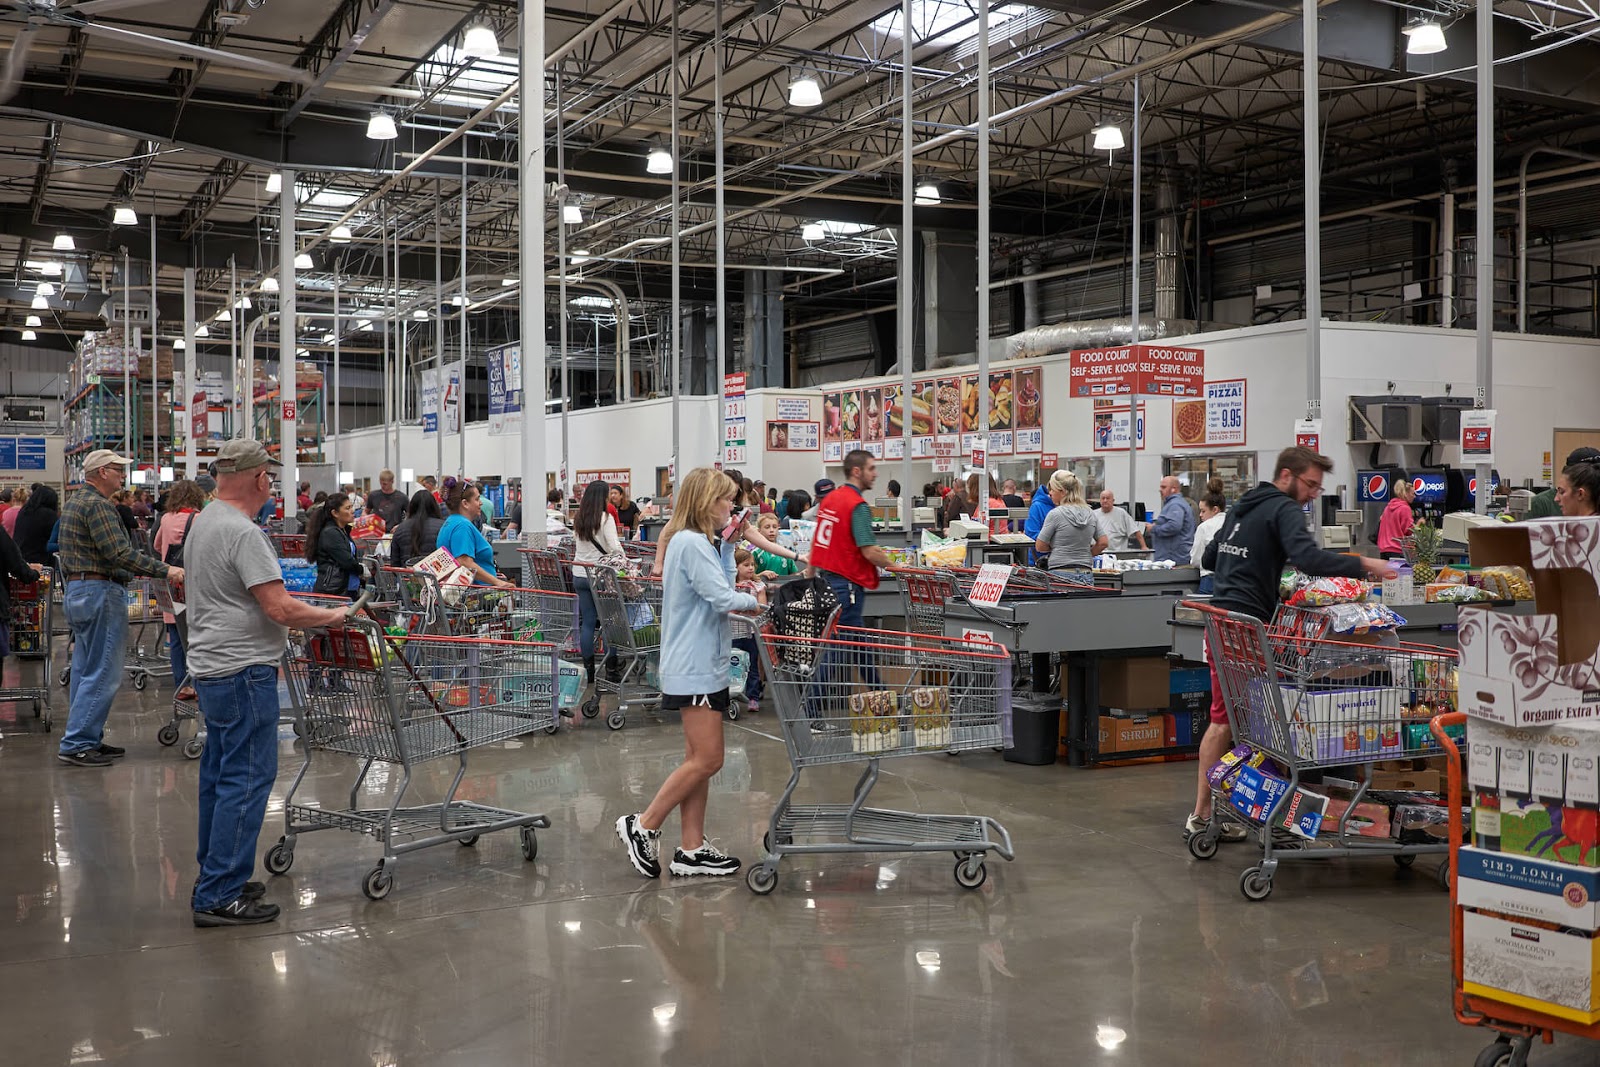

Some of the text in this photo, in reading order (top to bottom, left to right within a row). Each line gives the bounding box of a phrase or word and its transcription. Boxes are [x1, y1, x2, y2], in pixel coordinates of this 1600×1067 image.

[1080, 350, 1131, 362] FOOD COURT
[1149, 349, 1197, 362] FOOD COURT
[1071, 362, 1138, 377] SELF-SERVE KIOSK
[1140, 362, 1204, 376] SELF-SERVE KIOSK
[1208, 387, 1242, 399] PIZZA!
[1477, 387, 1485, 397] 15
[1222, 408, 1242, 428] 9.95
[1030, 432, 1041, 444] 4.99
[1425, 482, 1445, 492] pepsi
[969, 581, 1003, 603] CLOSED
[1337, 697, 1377, 712] spindrift
[1522, 708, 1564, 723] Organic
[1566, 706, 1592, 719] Extra
[1121, 728, 1160, 741] SHRIMP
[1260, 781, 1279, 821] EXTRA LARGE
[1300, 816, 1311, 829] 33
[1482, 858, 1563, 882] PINOT GRIS
[1500, 900, 1544, 915] VINEYARDS
[1494, 936, 1556, 957] SONOMA COUNTY
